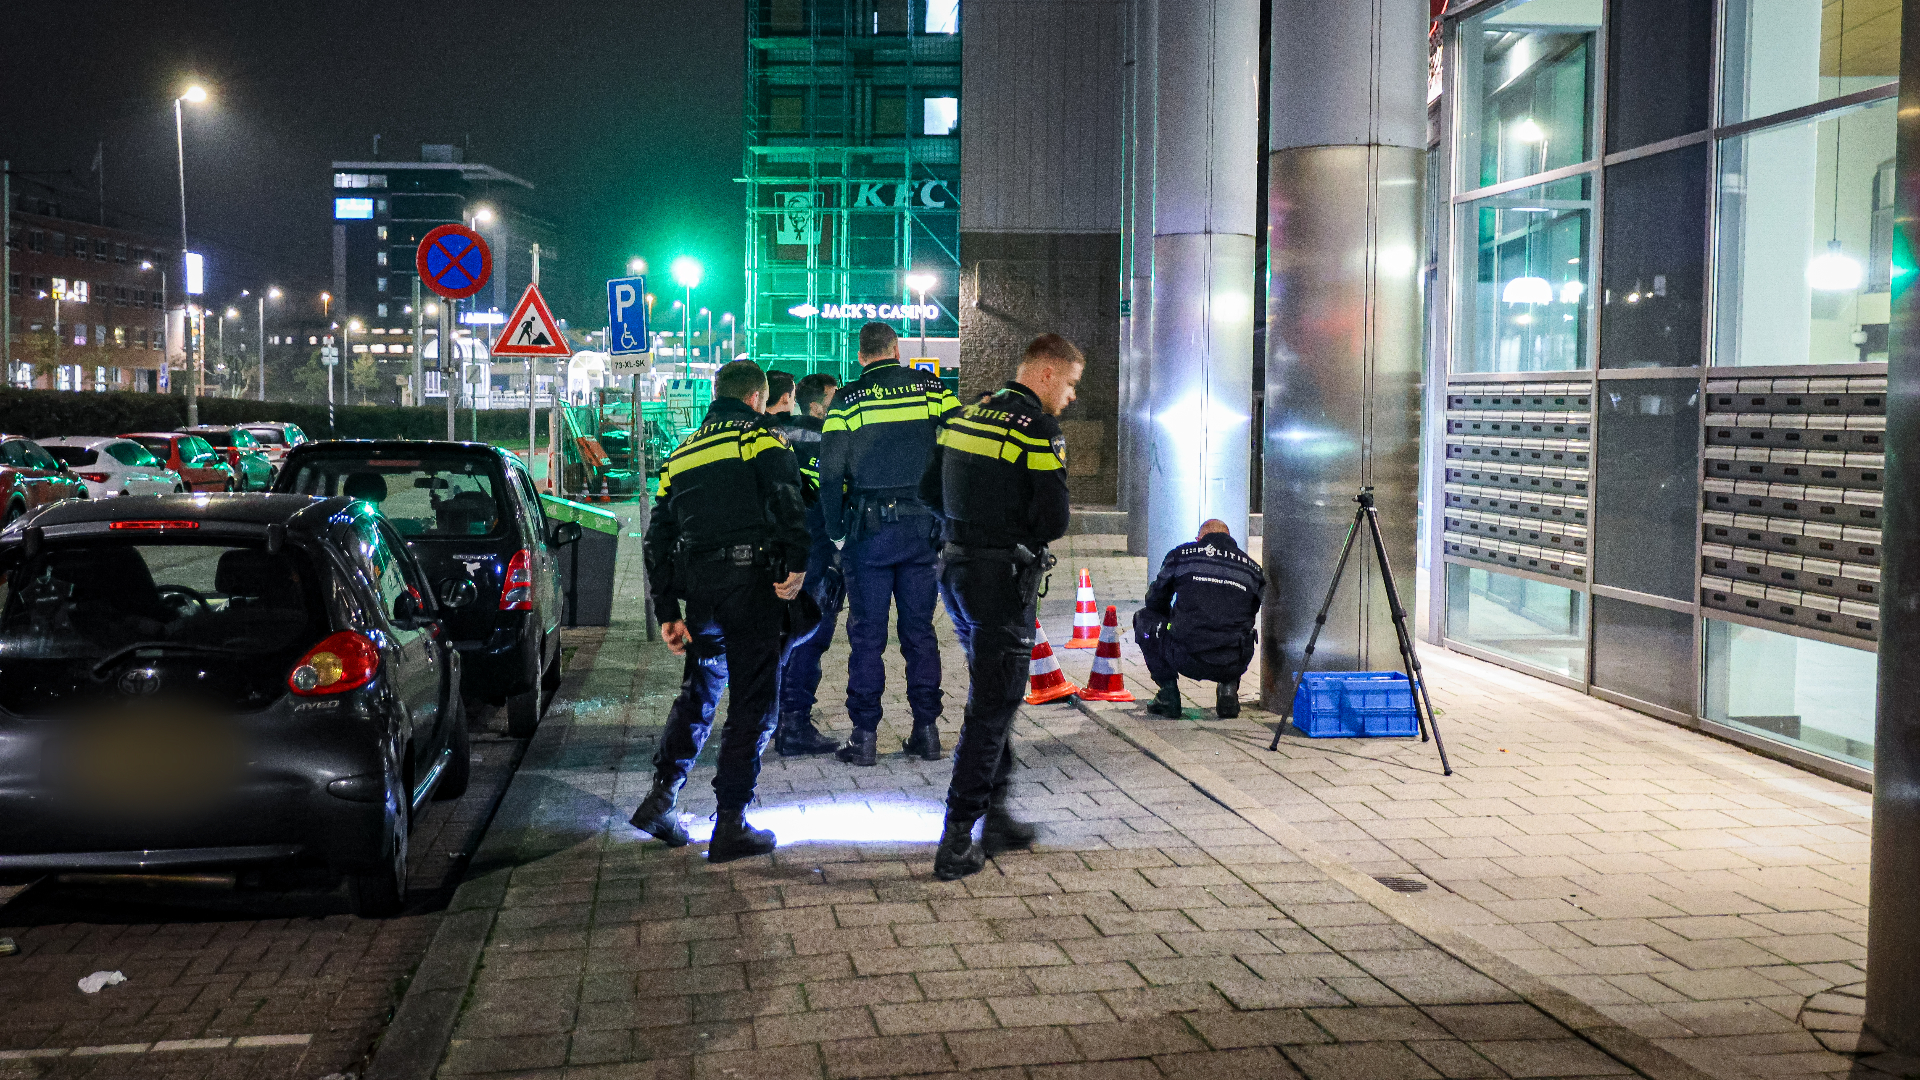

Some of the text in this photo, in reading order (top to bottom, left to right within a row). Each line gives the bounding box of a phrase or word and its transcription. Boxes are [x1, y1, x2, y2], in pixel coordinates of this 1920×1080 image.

[853, 180, 948, 208] KFC
[616, 284, 636, 322] P
[820, 304, 939, 319] JACK'S CASINO
[865, 383, 917, 399] POLITIE
[1198, 543, 1248, 564] POLITIE
